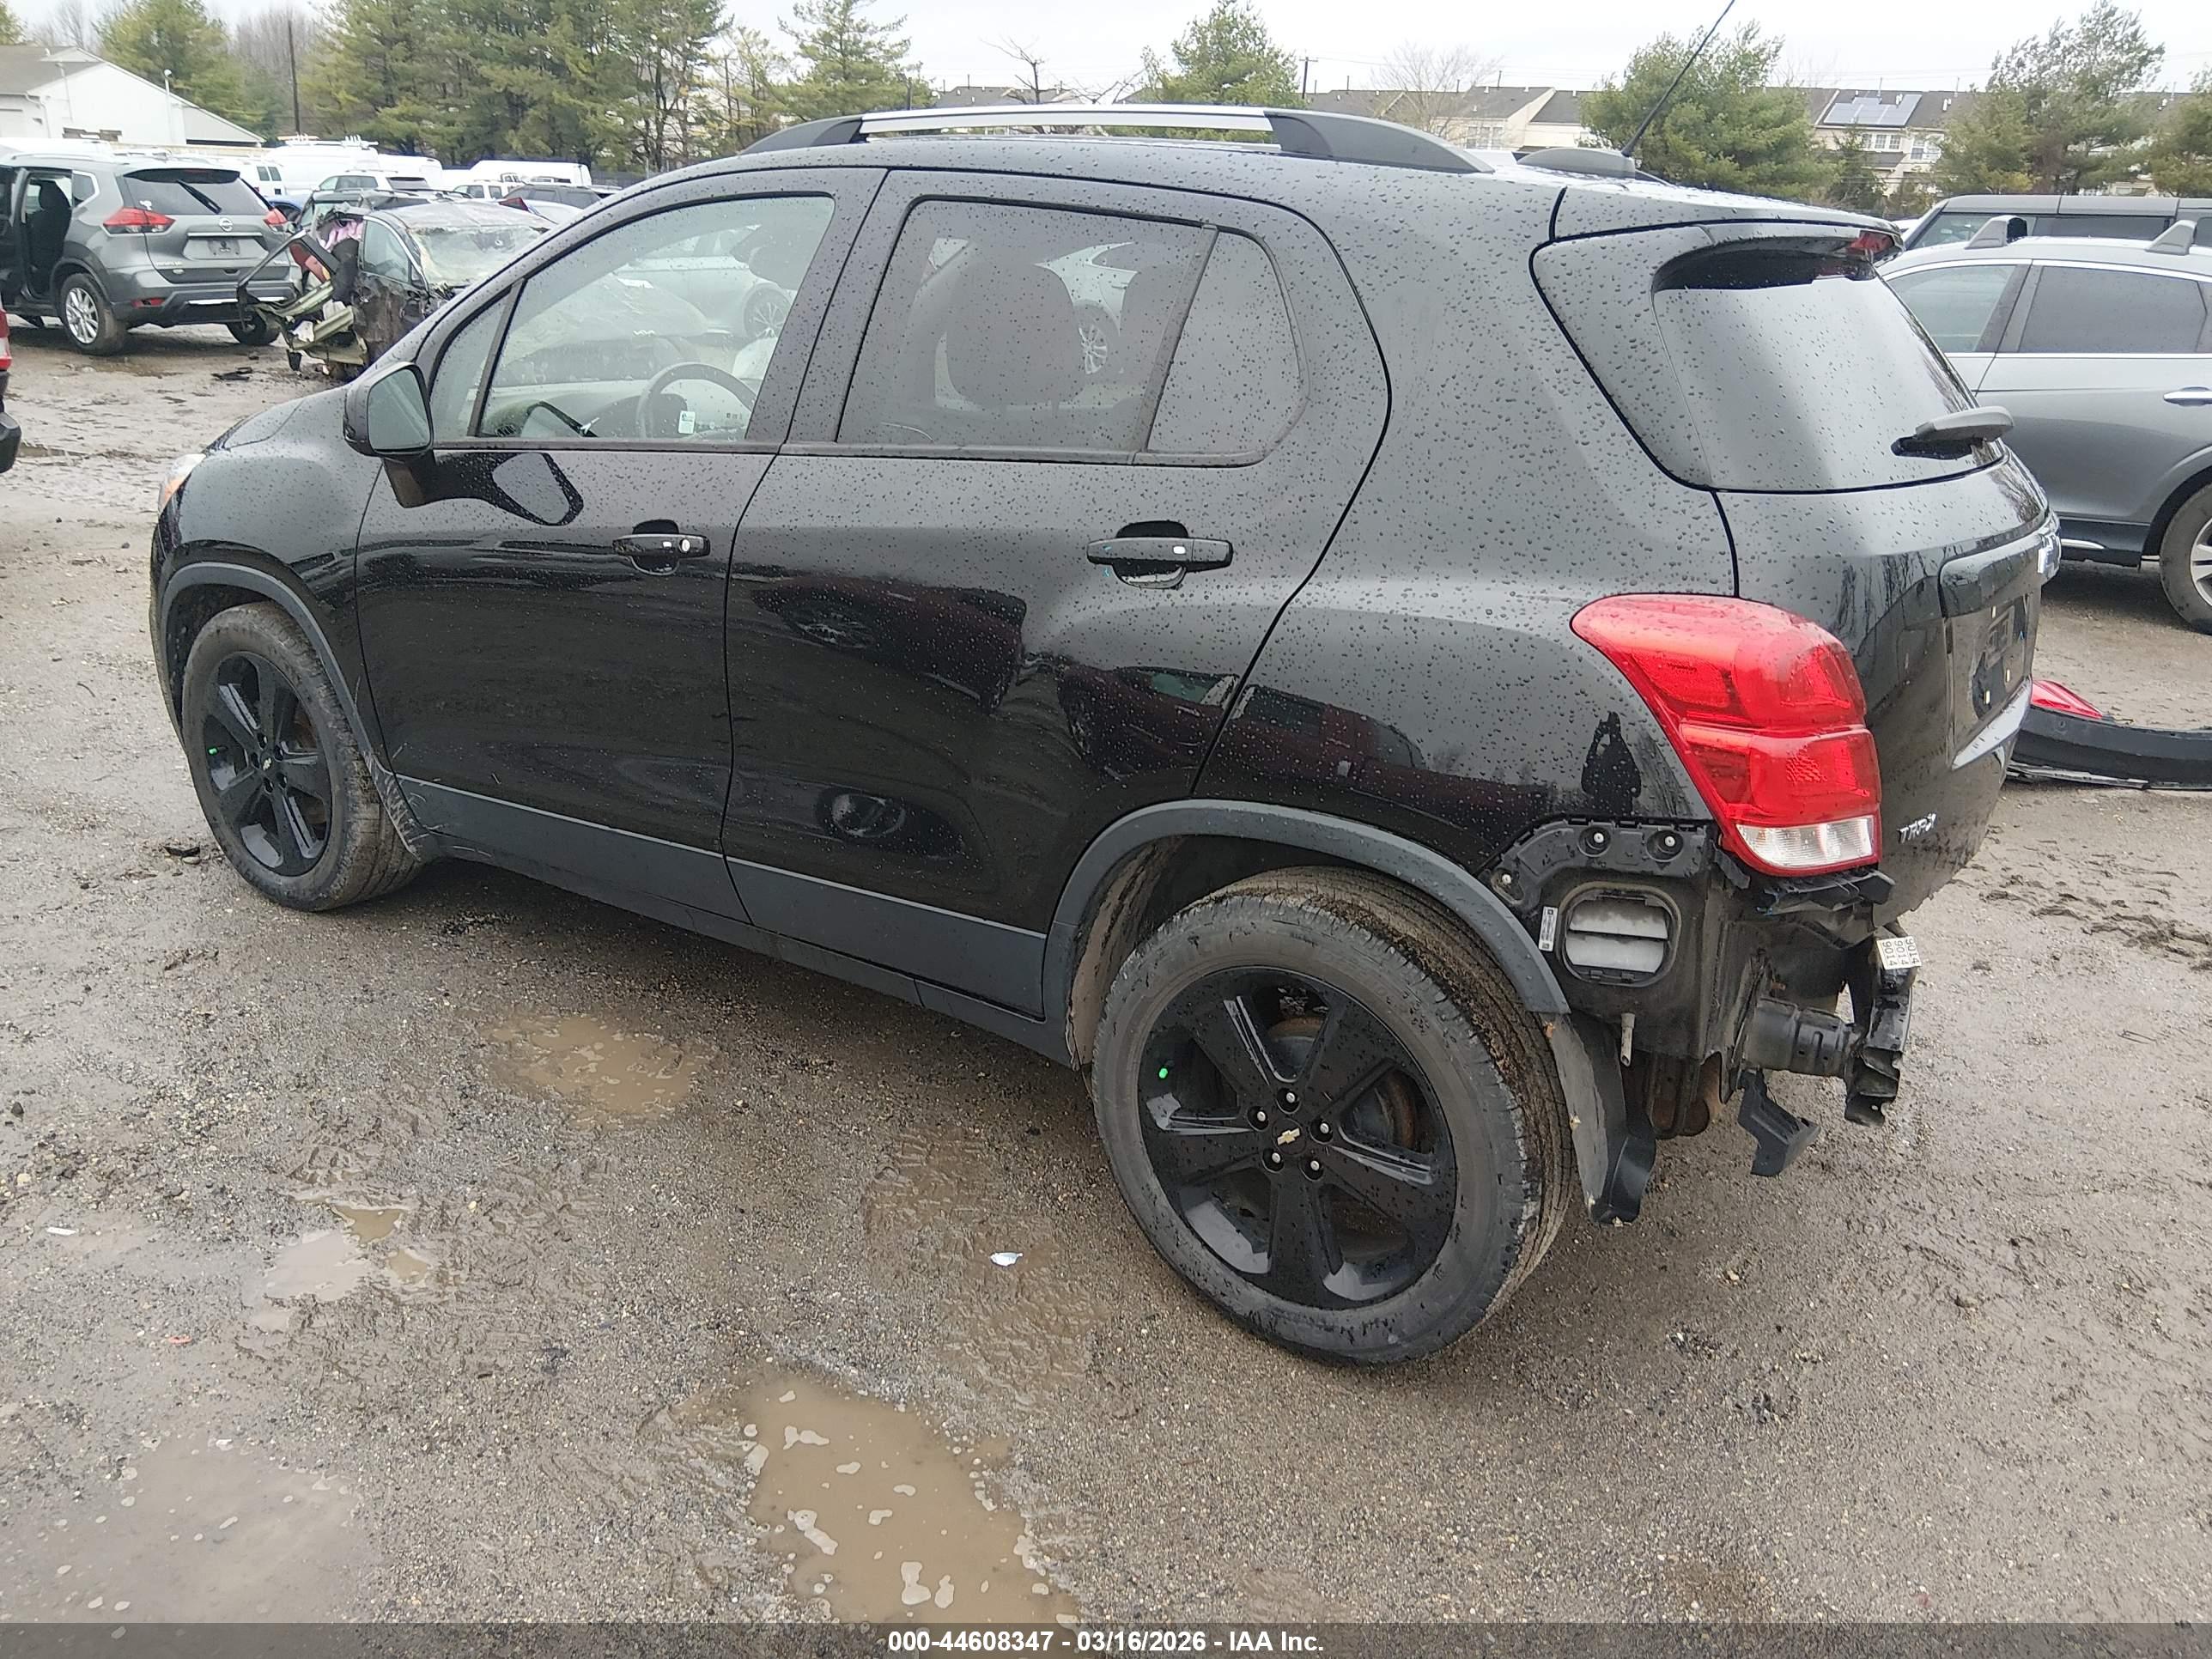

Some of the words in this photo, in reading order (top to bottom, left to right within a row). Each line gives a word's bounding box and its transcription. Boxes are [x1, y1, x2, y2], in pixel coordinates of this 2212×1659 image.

[1882, 941, 1898, 967] 9014
[1894, 940, 1909, 966] 9014
[1905, 938, 1920, 964] 9014
